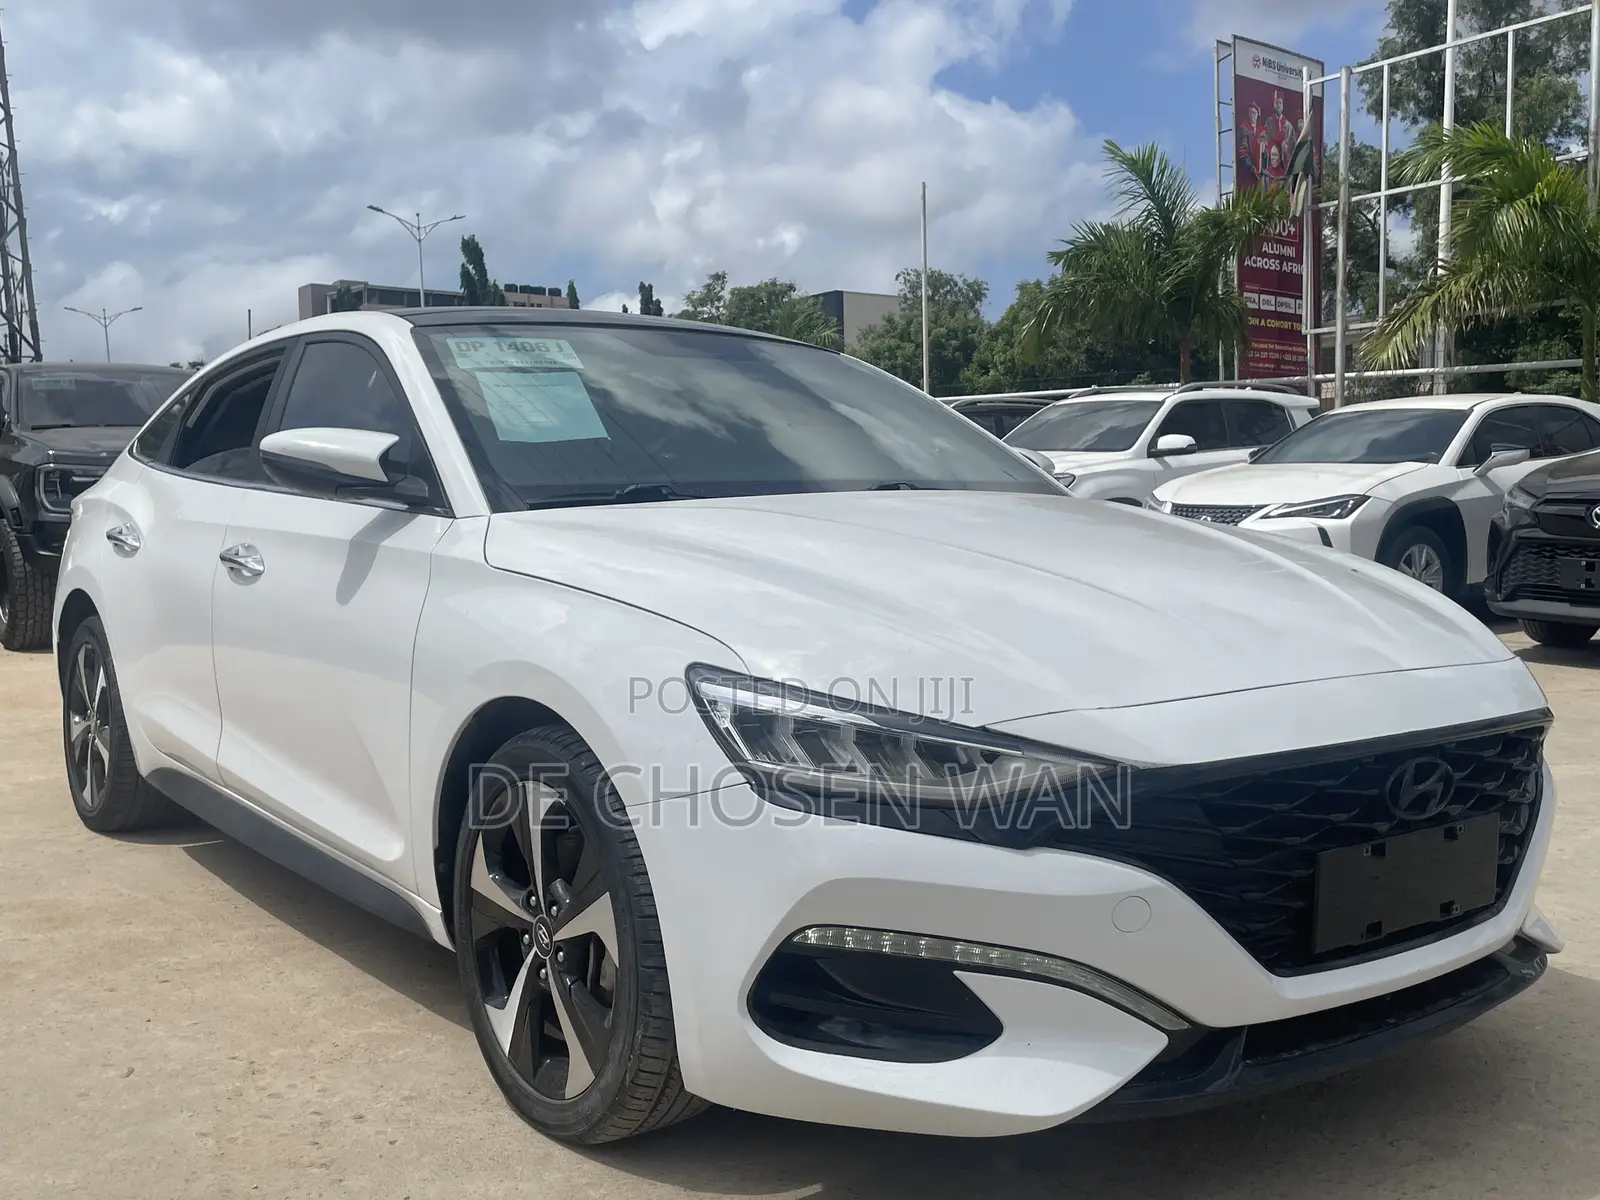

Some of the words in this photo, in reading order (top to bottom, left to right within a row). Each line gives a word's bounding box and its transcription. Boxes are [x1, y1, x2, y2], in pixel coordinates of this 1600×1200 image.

[1261, 241, 1296, 258] ALUMNI
[1244, 255, 1281, 272] ACROSS
[1260, 317, 1266, 328] A
[1266, 318, 1292, 330] COHORT
[455, 341, 486, 352] DP
[494, 341, 551, 353] 1406
